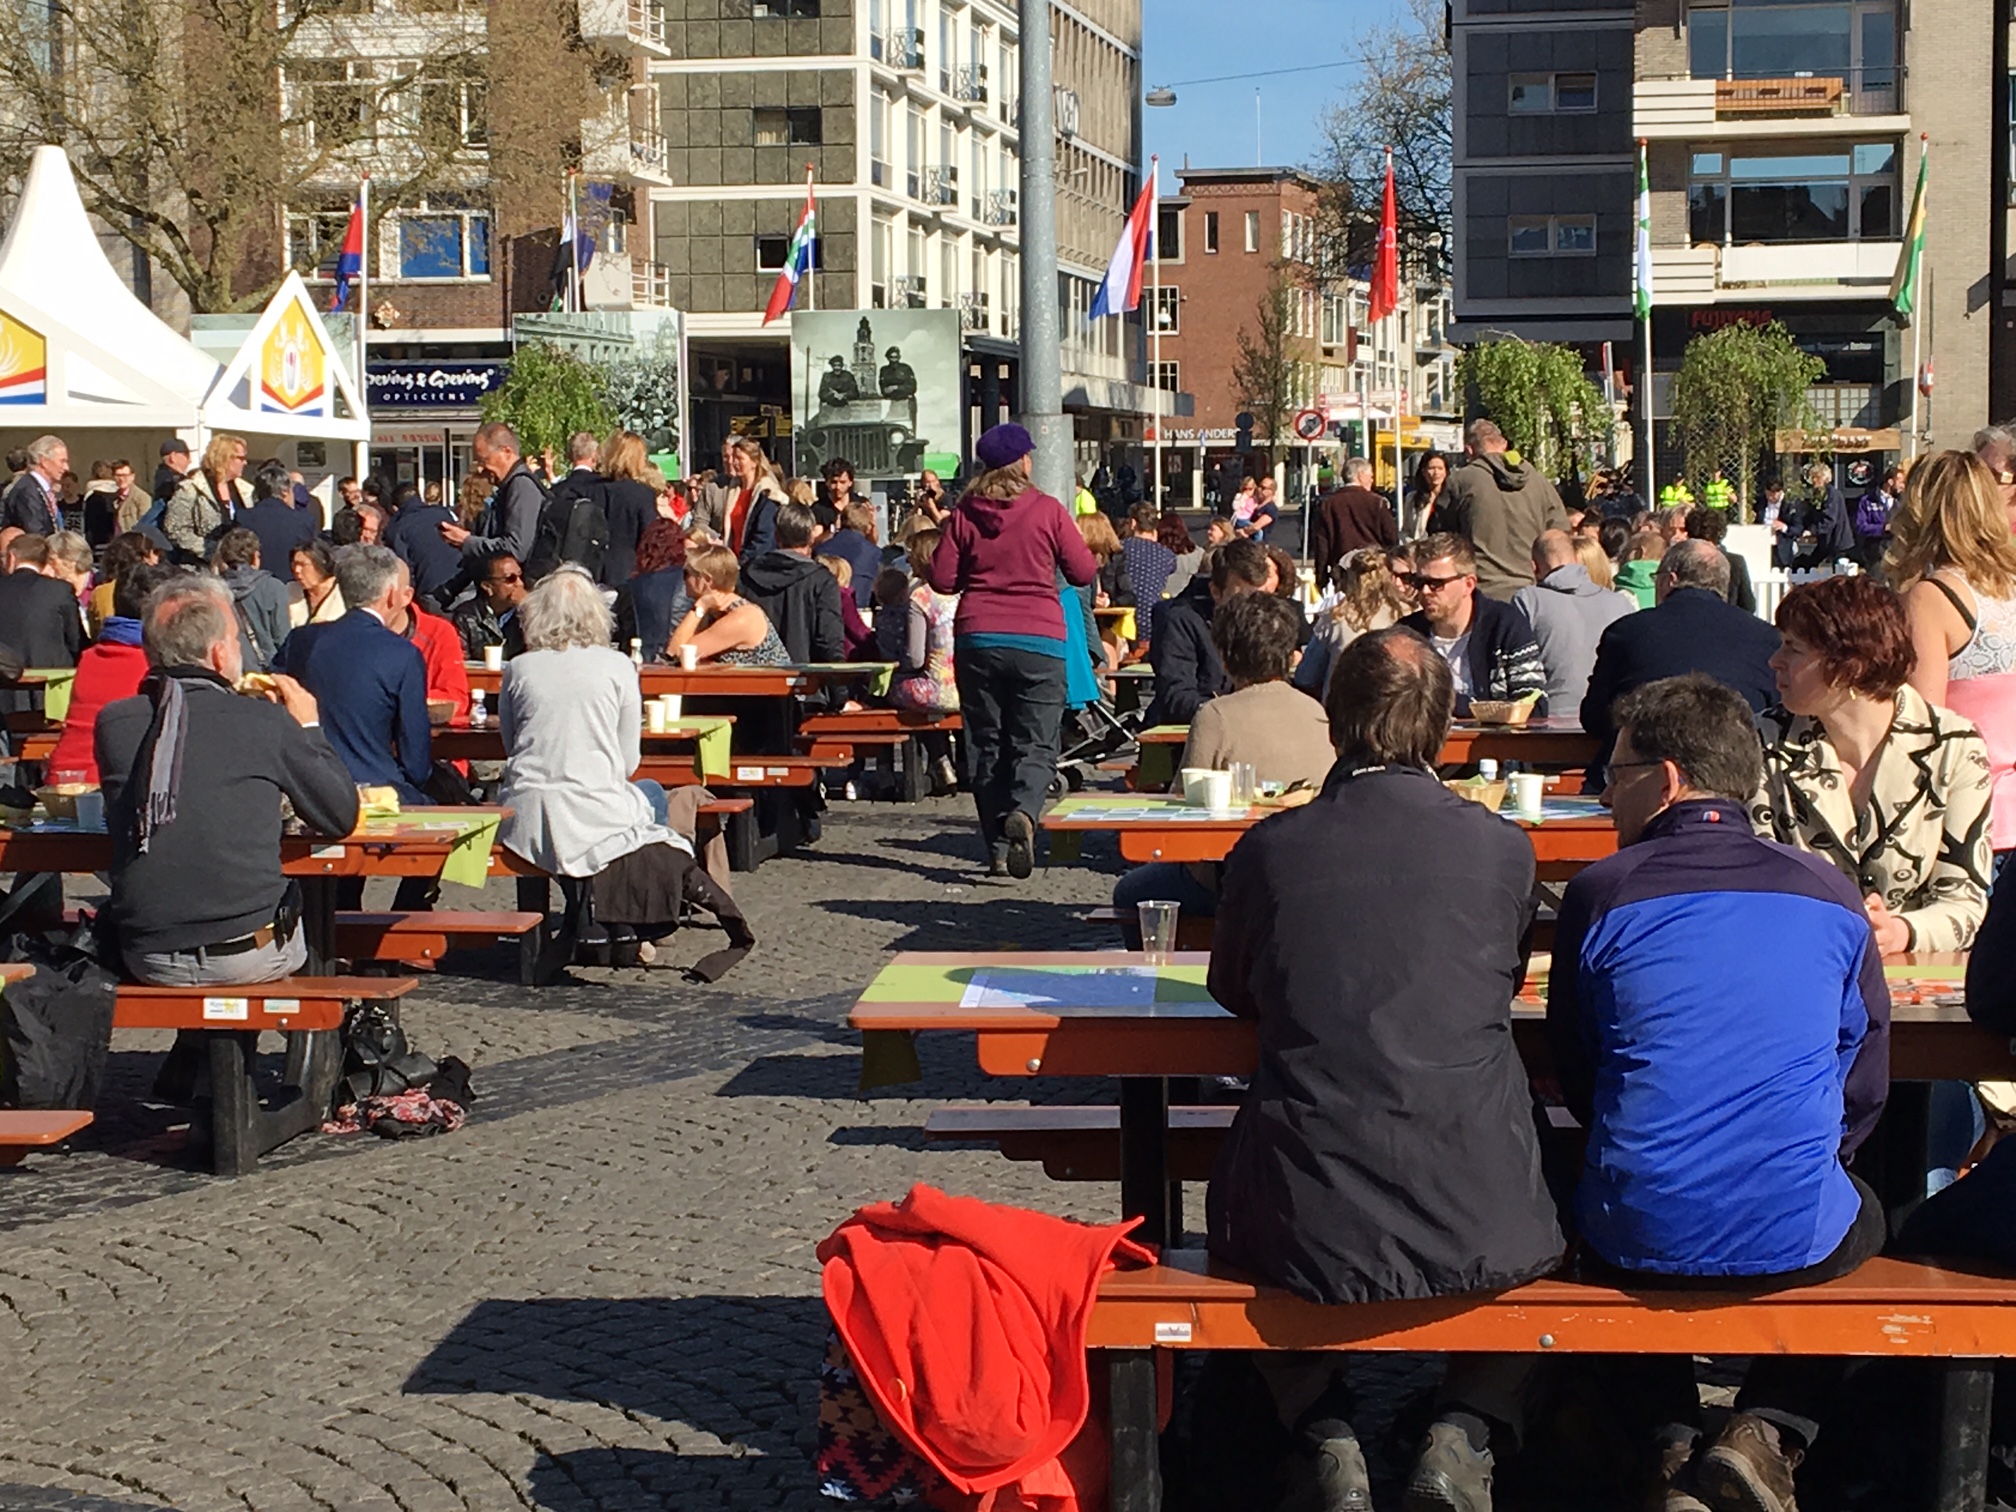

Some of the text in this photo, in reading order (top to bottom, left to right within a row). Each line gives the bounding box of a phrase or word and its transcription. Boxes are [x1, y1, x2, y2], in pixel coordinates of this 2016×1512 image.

[366, 369, 490, 390] reving & Greving
[382, 392, 466, 401] OPTICIENS
